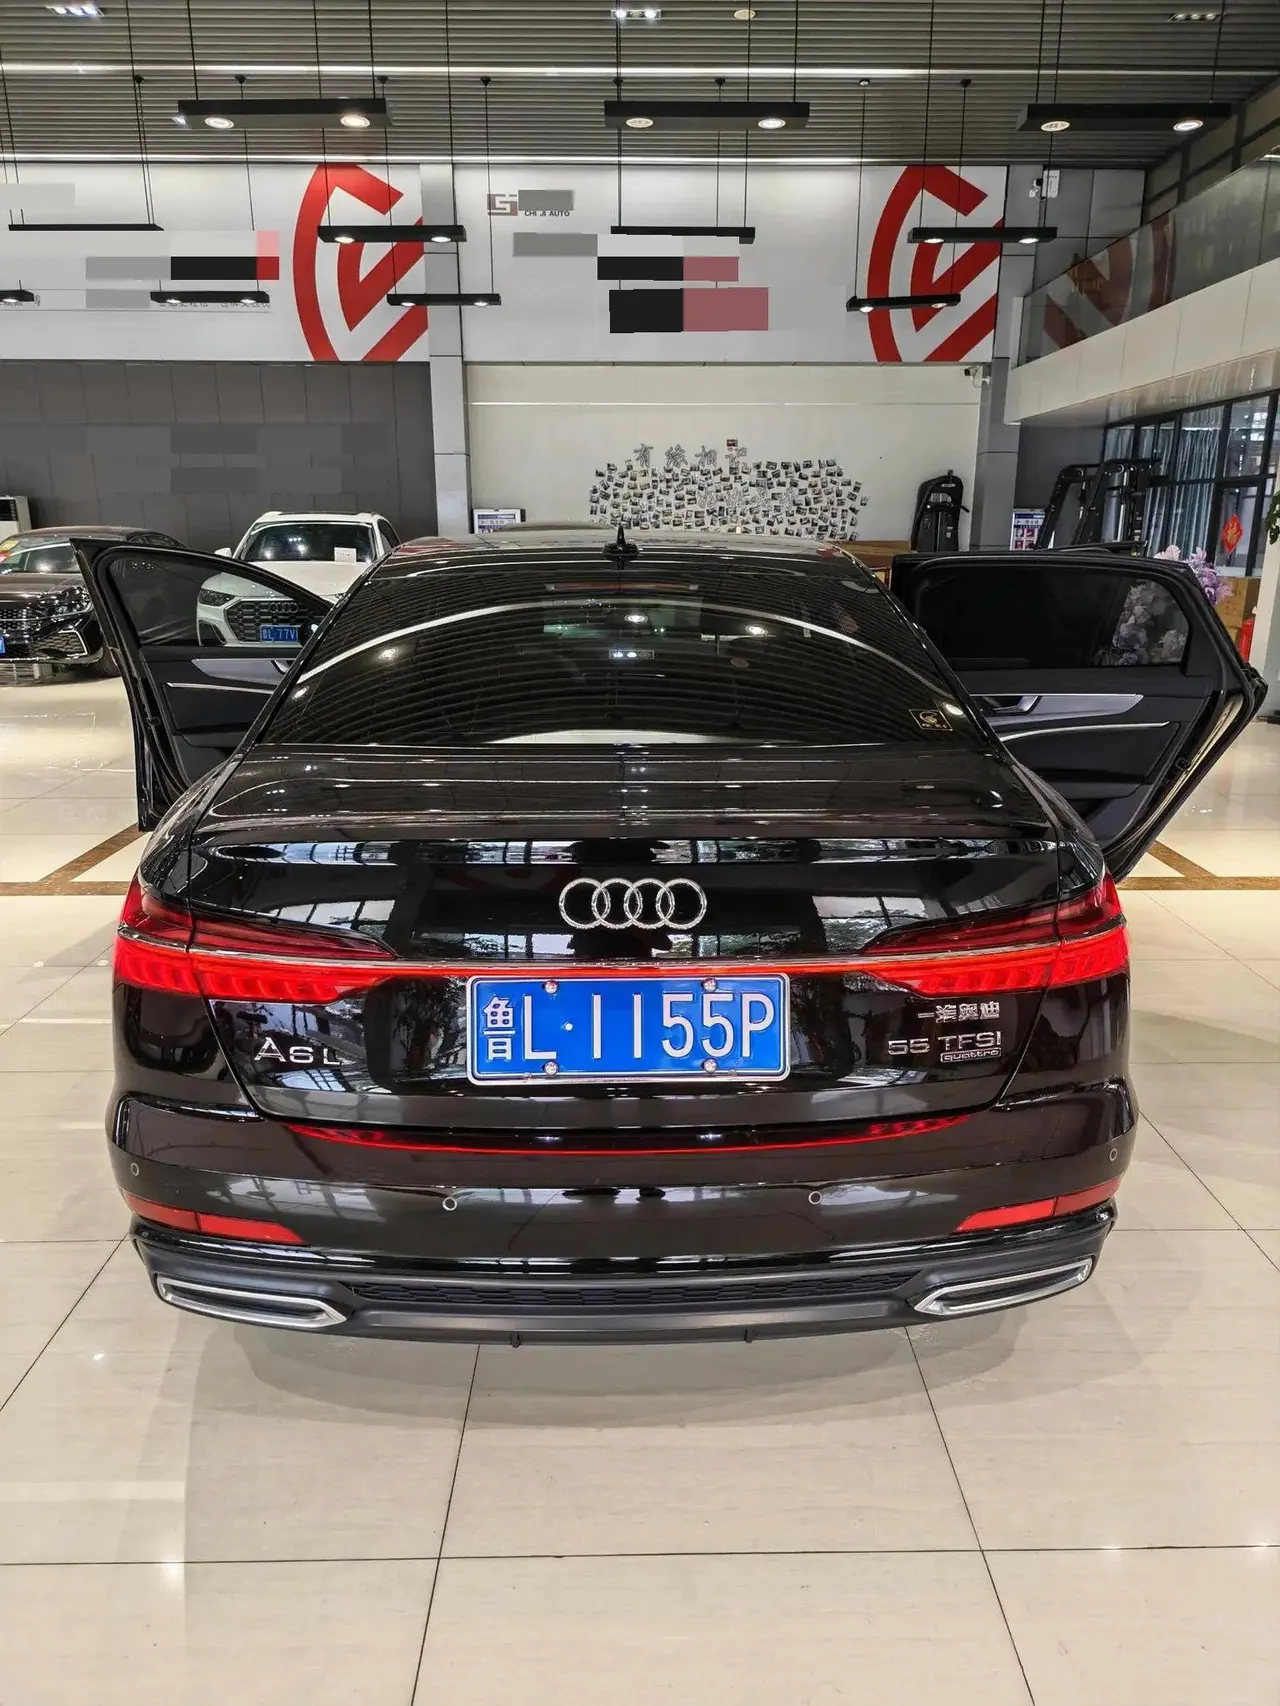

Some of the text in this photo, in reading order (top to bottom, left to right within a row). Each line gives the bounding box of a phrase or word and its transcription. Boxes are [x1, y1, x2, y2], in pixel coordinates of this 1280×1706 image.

[918, 1001, 1000, 1023] 一汽奥迪
[888, 1030, 1001, 1056] 55 TFSI
[943, 1049, 1000, 1061] quattro
